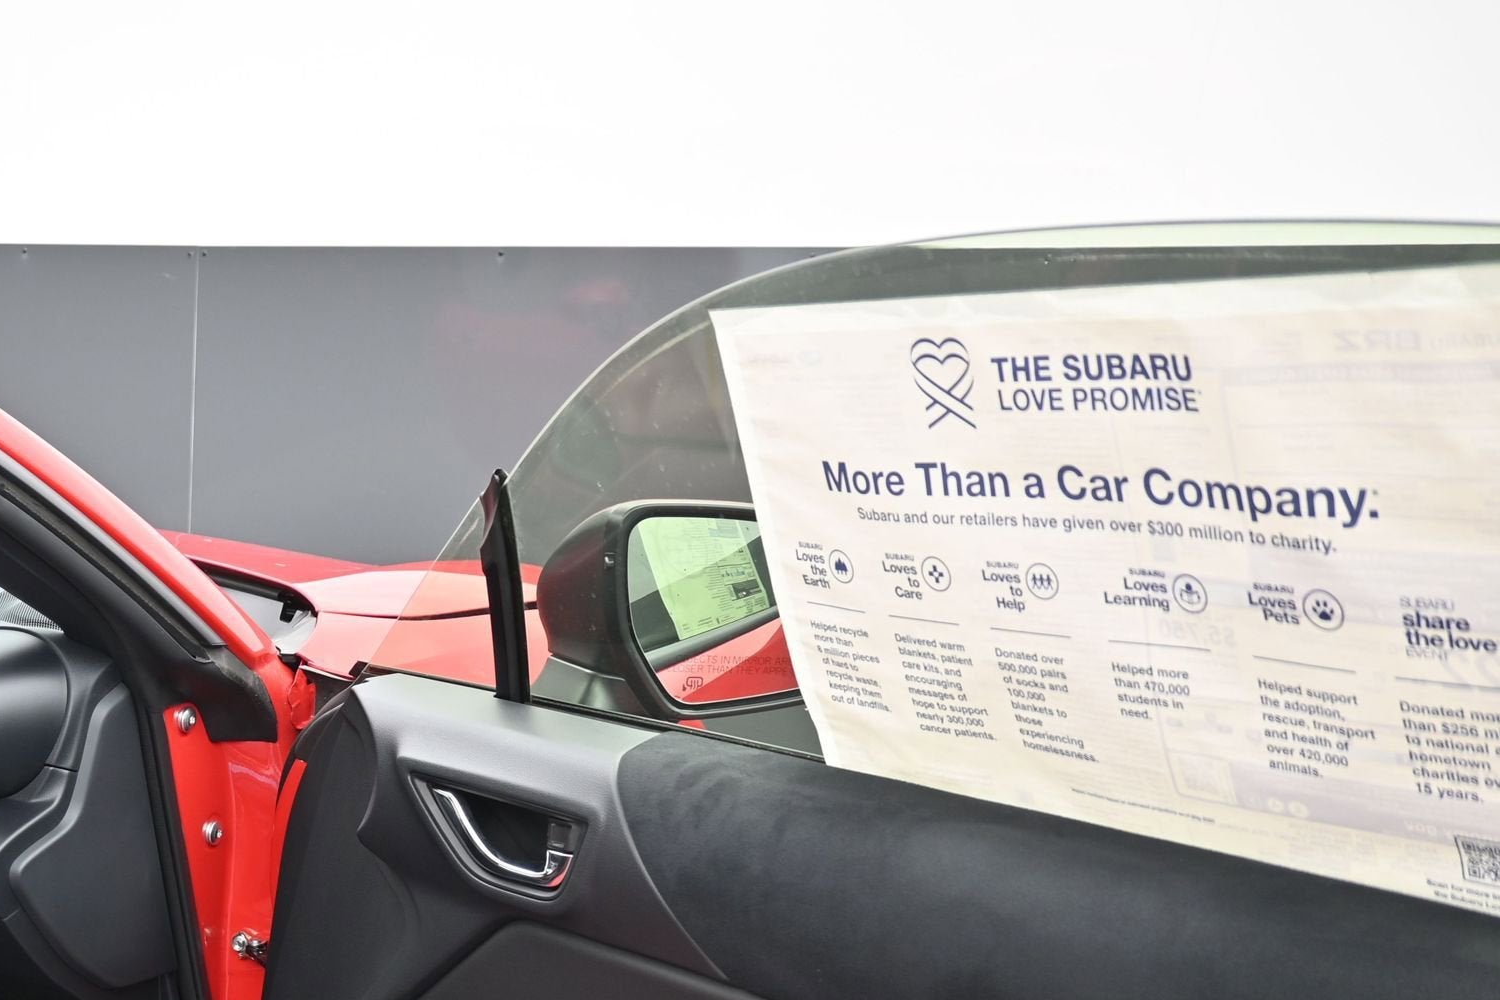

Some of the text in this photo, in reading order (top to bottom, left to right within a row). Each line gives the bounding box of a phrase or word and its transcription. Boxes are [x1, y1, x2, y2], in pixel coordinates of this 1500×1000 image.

[991, 354, 1192, 382] THE SUBARU
[998, 388, 1199, 412] LOVE PROMISE
[822, 461, 905, 496] More
[915, 462, 1010, 498] Than
[1022, 472, 1045, 499] a
[1057, 465, 1128, 501] Car
[857, 507, 1337, 555] Subaru and our retailers have given over $300 million to charity.
[798, 541, 823, 550] SUBARU
[796, 549, 825, 564] Loves
[986, 561, 1019, 569] SUBARU
[811, 565, 827, 576] the
[882, 560, 917, 575] Loves
[1129, 568, 1165, 578] SUBARU
[803, 574, 831, 589] Earth
[908, 576, 920, 588] to
[982, 570, 1021, 584] Loves
[1123, 578, 1168, 594] Loves
[895, 586, 922, 600] Care
[1010, 585, 1023, 597] to
[1252, 582, 1294, 594] SUBARU
[996, 597, 1025, 612] Help
[1104, 591, 1170, 612] Learning
[1247, 591, 1297, 611] Loves
[1262, 609, 1300, 625] Pets
[1402, 610, 1470, 631] share
[810, 620, 869, 638] Helped recycle
[814, 634, 854, 647] more than
[894, 633, 965, 652] Delivered warm
[1405, 630, 1498, 653] the love
[676, 655, 718, 665] JECTS
[721, 655, 731, 665] IN
[824, 647, 850, 658] million
[852, 652, 880, 664] pieces
[898, 646, 973, 667] blankets, patient
[995, 647, 1064, 665] Donated over
[707, 664, 732, 674] THAN
[736, 664, 760, 675] THEY
[762, 665, 792, 675] APPE
[826, 670, 854, 681] recycle
[902, 660, 921, 671] care
[944, 668, 962, 677] and
[998, 661, 1067, 680] 500,000 pairs
[1112, 662, 1189, 680] Helped more
[829, 680, 882, 699] keeping them
[905, 674, 963, 691] encouraging
[1003, 675, 1069, 693] of socks and
[1114, 677, 1190, 696] than 470,000
[1258, 678, 1358, 705] Helped support
[831, 695, 845, 703] out
[846, 697, 855, 705] of
[908, 686, 968, 702] messages of
[1007, 687, 1046, 701] 100,000
[1117, 693, 1184, 710] students in
[911, 698, 989, 716] hope to support
[1011, 700, 1067, 718] blankets to
[1120, 708, 1152, 721] need.
[1260, 695, 1346, 722] the adoption,
[1399, 700, 1465, 719] Donated
[916, 711, 985, 727] nearly 300,000
[1014, 714, 1043, 727] those
[1262, 712, 1376, 740] rescue, transport
[1402, 718, 1437, 733] than
[1442, 721, 1479, 738] $256
[920, 723, 998, 741] cancer patients.
[1019, 728, 1084, 749] experiencing
[1264, 728, 1350, 752] and health of
[1022, 739, 1100, 763] homelessness.
[1405, 734, 1421, 746] to
[1426, 738, 1490, 754] national
[1267, 744, 1349, 768] over 420,000
[1409, 750, 1491, 771] hometown
[1269, 758, 1323, 779] animals.
[1413, 766, 1479, 785] charities
[1416, 782, 1484, 803] 15 years.
